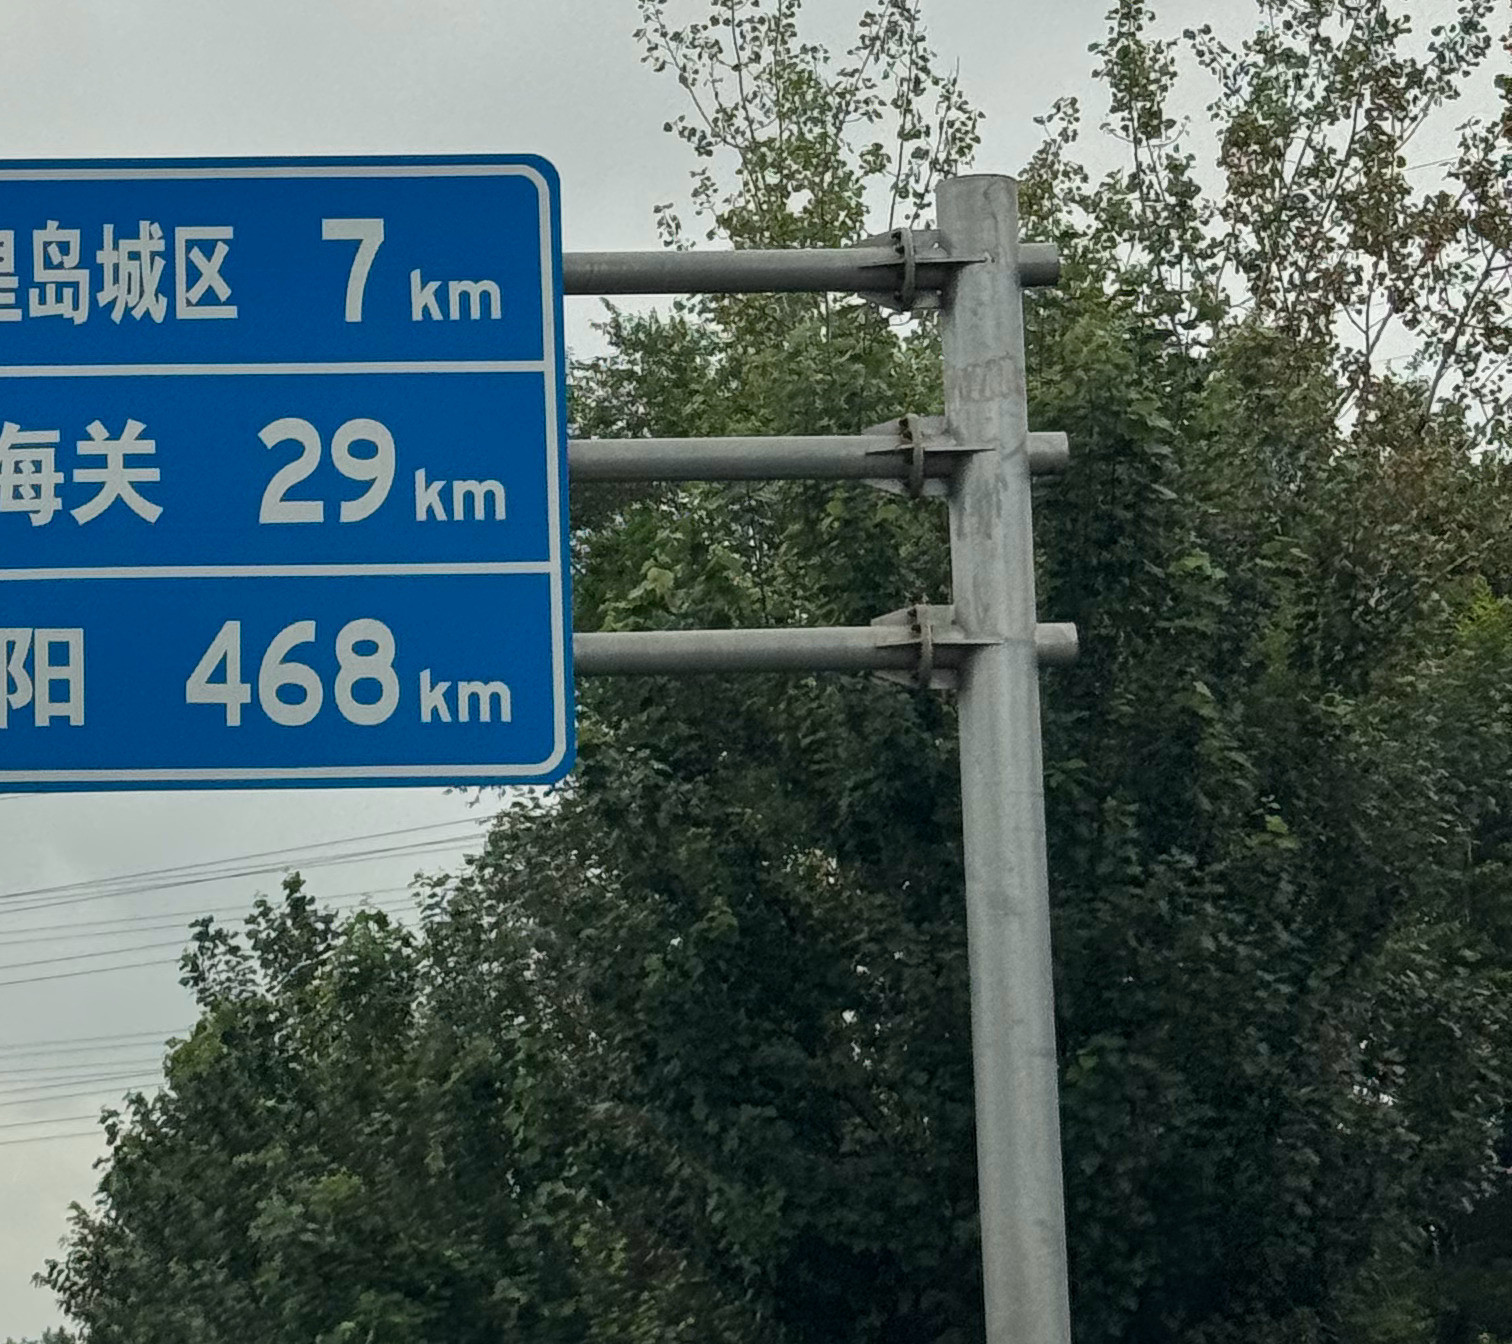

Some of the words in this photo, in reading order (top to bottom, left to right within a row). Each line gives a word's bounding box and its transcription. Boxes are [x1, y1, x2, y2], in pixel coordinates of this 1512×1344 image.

[322, 219, 384, 322] 7
[411, 269, 501, 320] km
[258, 418, 395, 523] 29
[415, 469, 506, 520] km
[186, 619, 399, 726] 468
[420, 670, 511, 722] km
